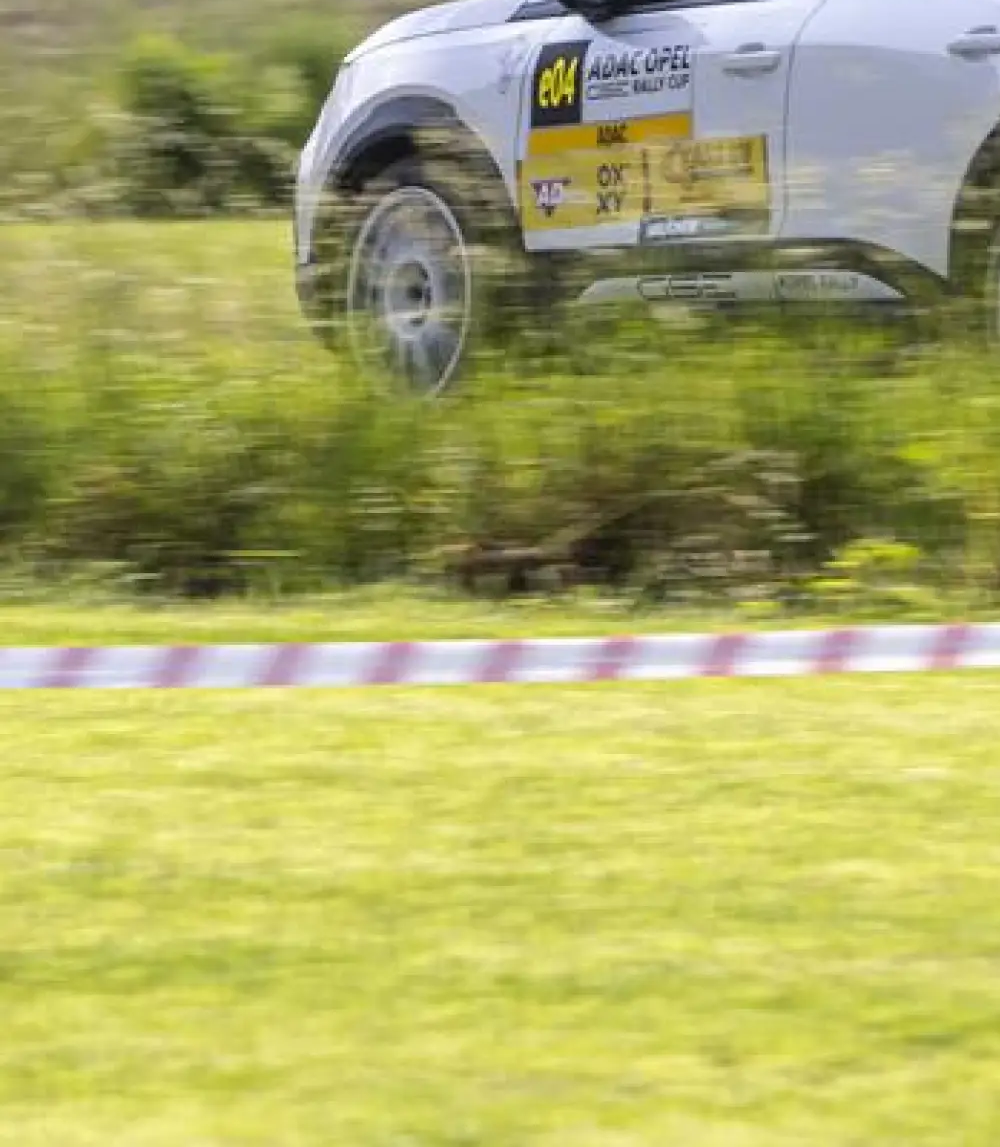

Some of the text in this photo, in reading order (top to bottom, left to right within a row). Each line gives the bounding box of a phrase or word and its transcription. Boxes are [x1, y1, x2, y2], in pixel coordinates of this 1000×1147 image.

[588, 44, 690, 80] ADAC OPEL
[538, 56, 578, 108] e04
[668, 73, 690, 90] CUP
